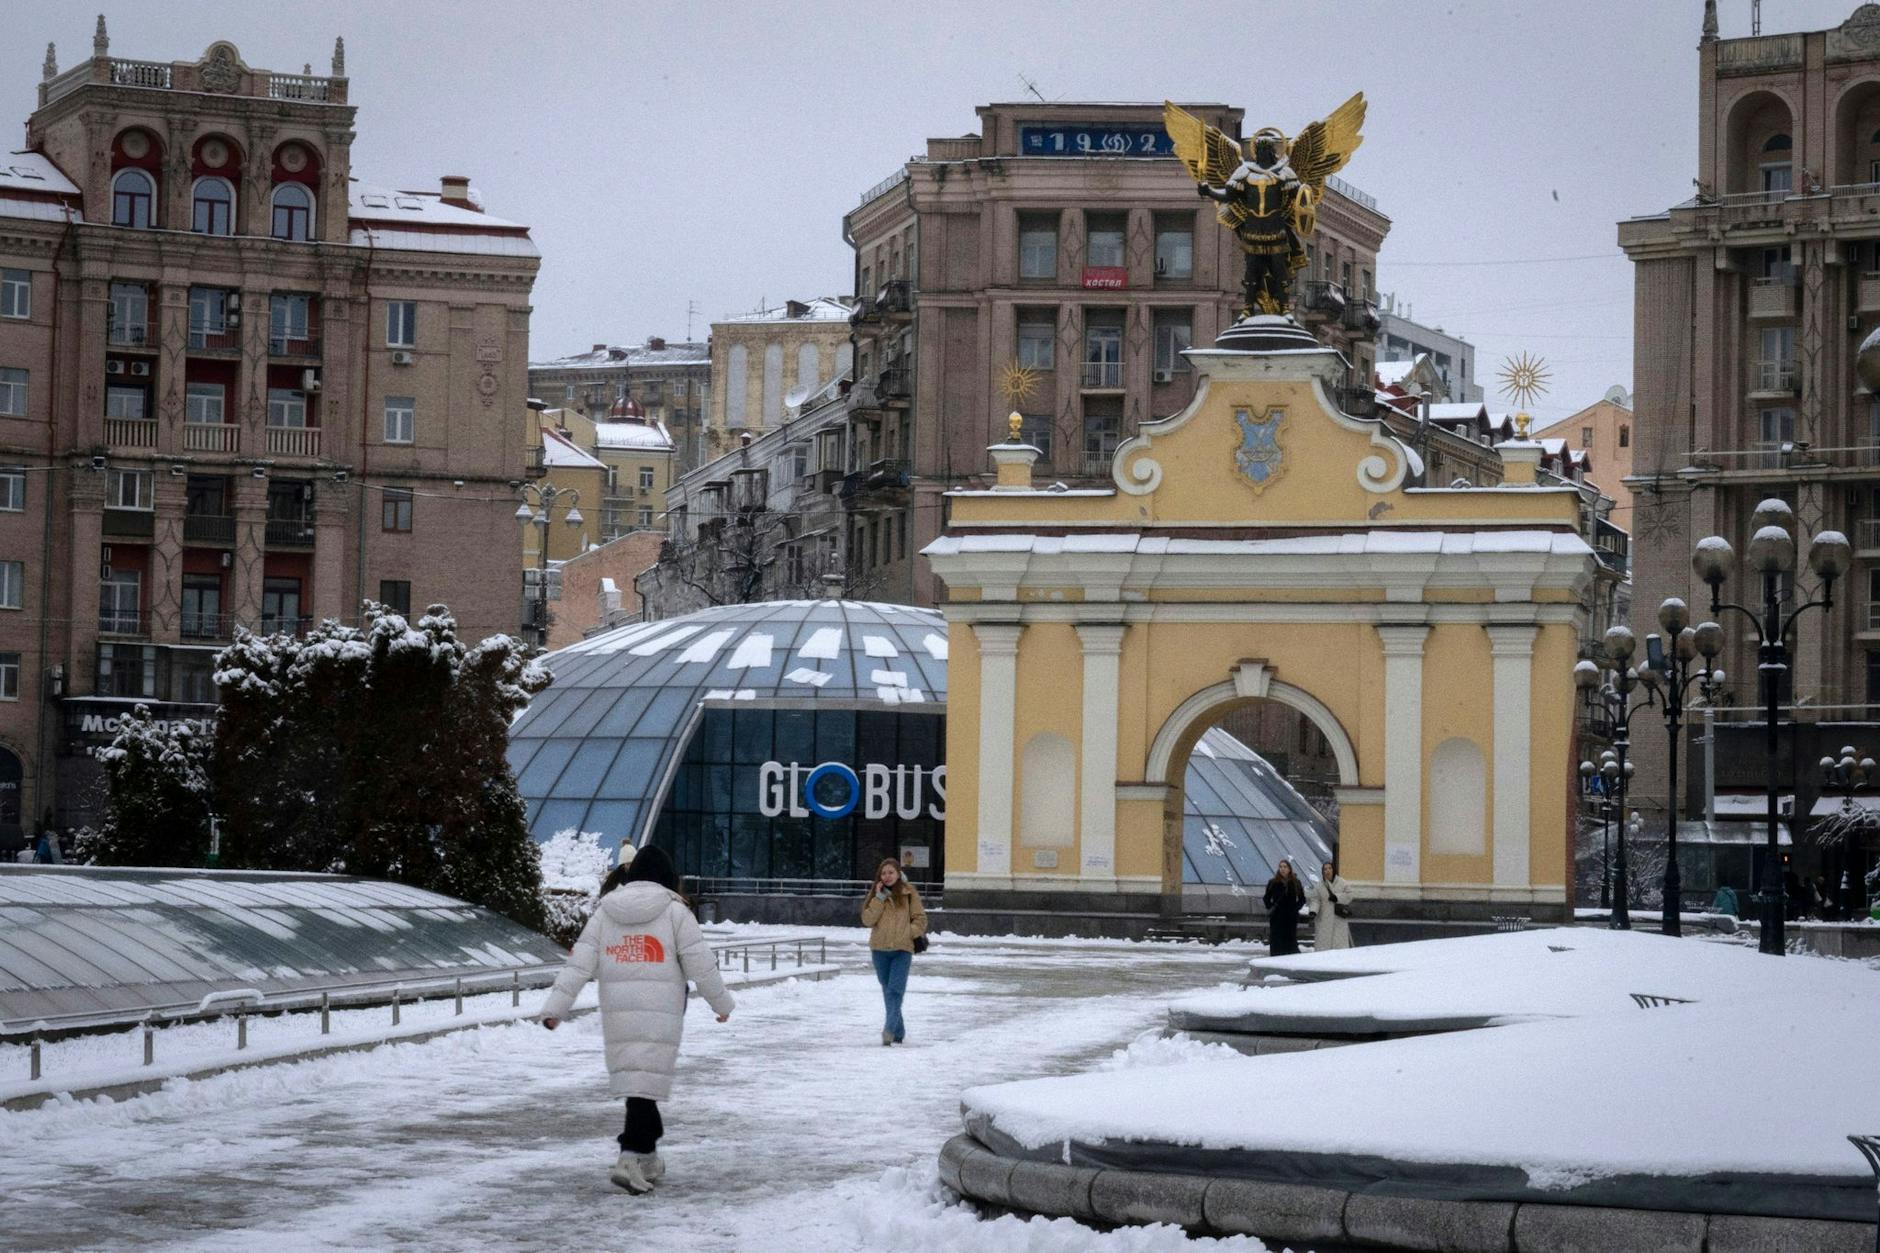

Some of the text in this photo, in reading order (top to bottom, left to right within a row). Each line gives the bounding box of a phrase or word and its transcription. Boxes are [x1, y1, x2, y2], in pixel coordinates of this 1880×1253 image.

[759, 761, 945, 820] GLOBUS
[623, 935, 643, 944] THE
[606, 944, 643, 955] NORTH
[616, 953, 643, 963] FACE
